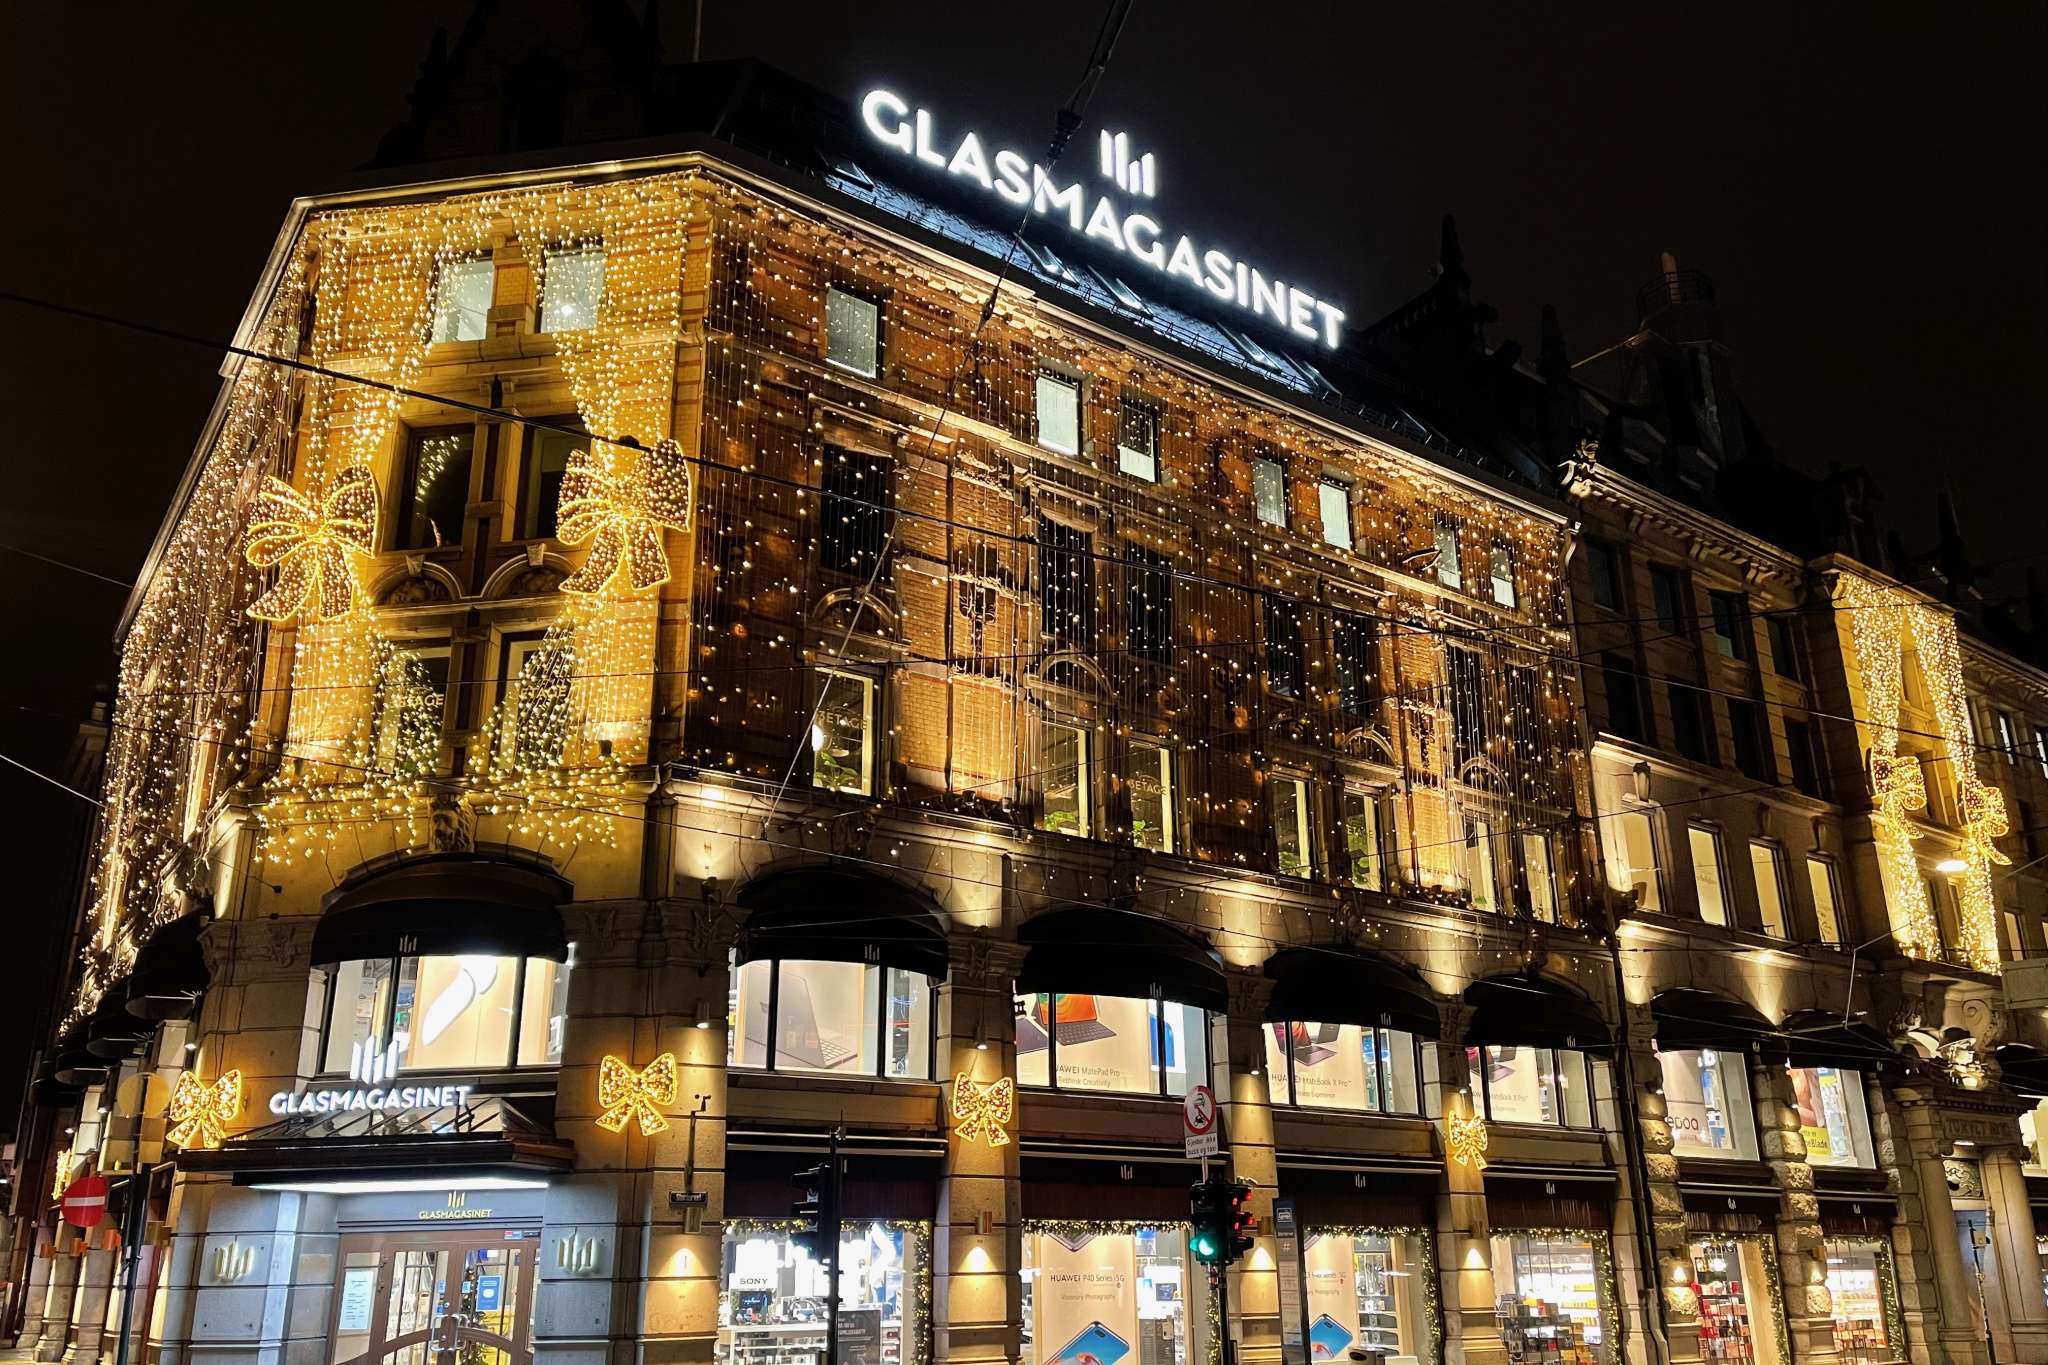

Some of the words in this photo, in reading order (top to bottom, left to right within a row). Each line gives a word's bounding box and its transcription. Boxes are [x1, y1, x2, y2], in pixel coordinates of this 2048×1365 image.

[862, 89, 1345, 349] GLASMAGASINET
[1271, 1073, 1300, 1083] HUAEI
[269, 1086, 470, 1114] GLASMAGASINET
[418, 1209, 493, 1219] GLASMAGASINET
[1050, 1274, 1081, 1283] HUAWEI
